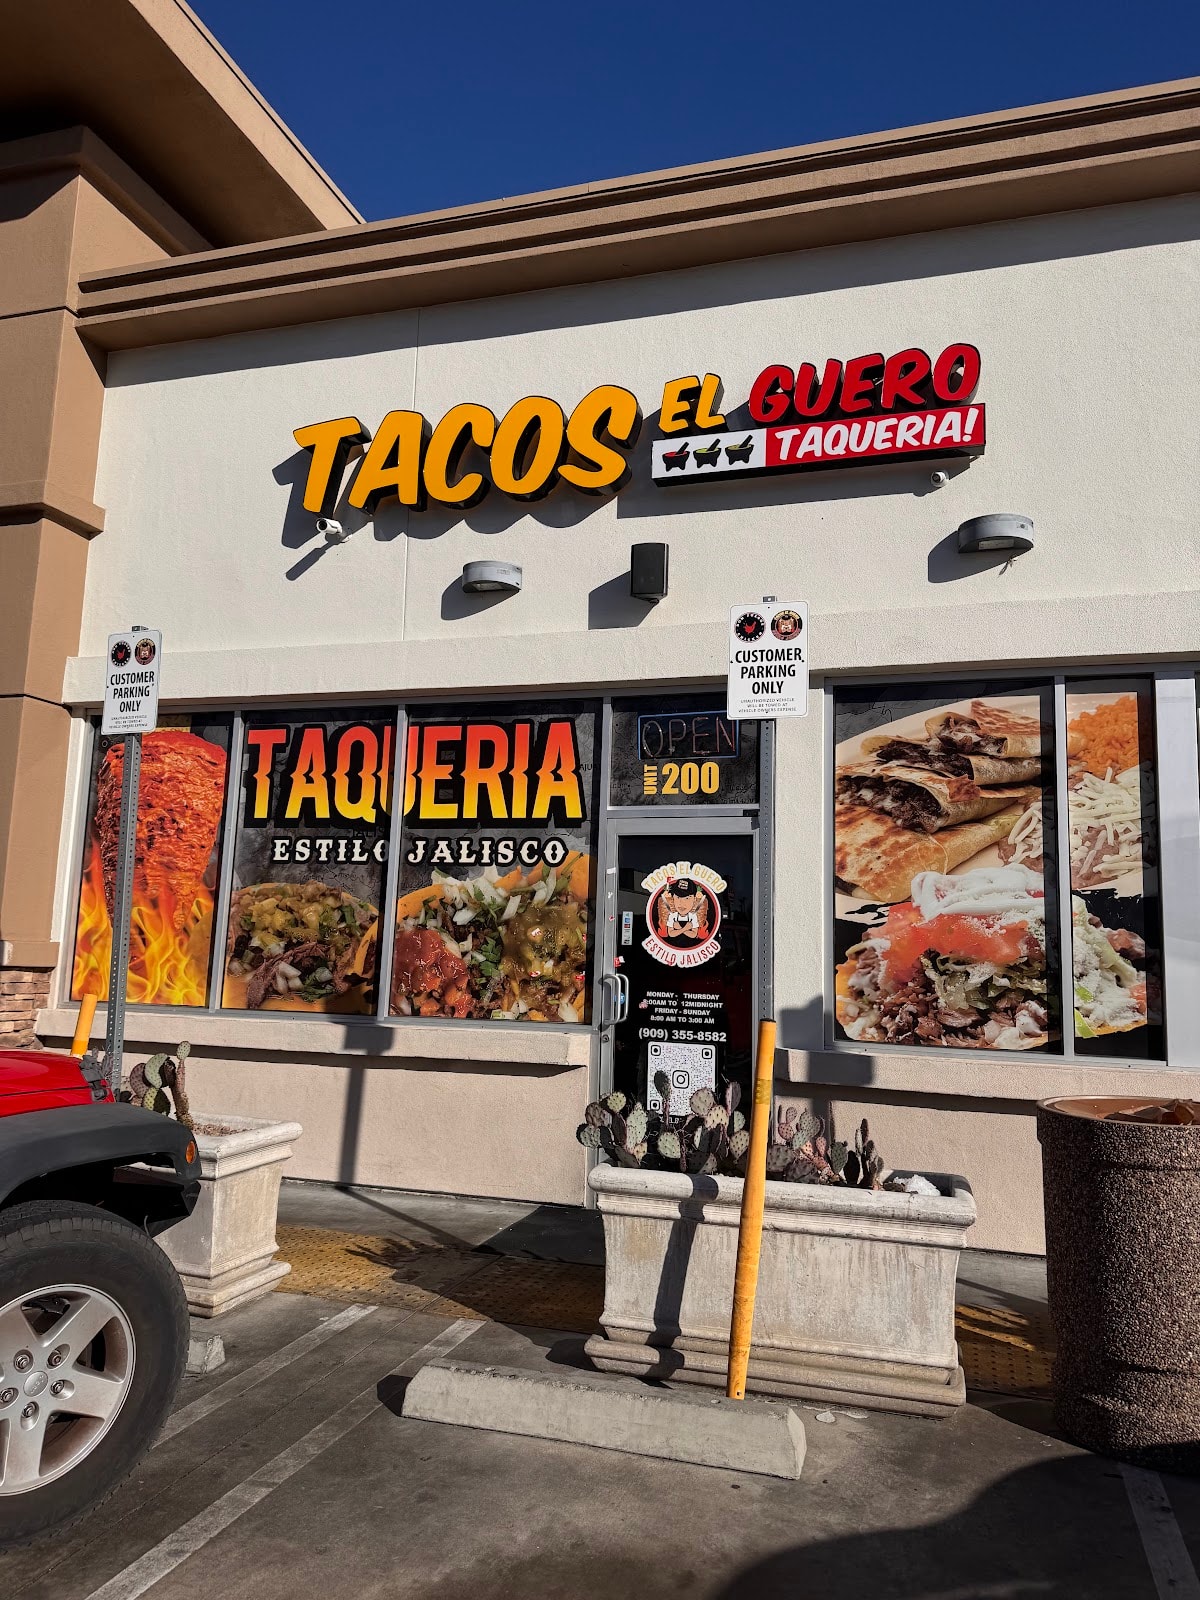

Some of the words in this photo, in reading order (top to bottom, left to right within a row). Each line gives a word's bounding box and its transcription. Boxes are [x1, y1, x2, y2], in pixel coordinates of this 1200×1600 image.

[292, 384, 640, 514] TACOS
[658, 373, 725, 432] EL
[748, 343, 982, 423] GUERO
[775, 408, 979, 460] TAQUERIA!
[735, 648, 802, 663] CUSTOMER
[110, 671, 154, 685] CUSTOMER
[741, 664, 796, 679] PARKING
[113, 685, 150, 699] PARKING
[752, 681, 784, 694] ONLY
[119, 700, 142, 713] ONLY
[642, 716, 736, 757] OPEN
[248, 721, 583, 823] TAQUERIA
[644, 764, 657, 795] UNIT
[661, 761, 720, 795] 200
[407, 839, 567, 864] JALISCO
[645, 865, 676, 890] TACOS
[680, 864, 690, 874] EL
[694, 866, 726, 891] GUERO
[645, 938, 677, 965] ESTILO
[680, 941, 720, 966] JALISCO
[681, 1000, 724, 1008] 12MIDNIGHT
[683, 992, 720, 1000] THURSDAY
[638, 1027, 669, 1041] (909)
[671, 1029, 727, 1042] 355-8582
